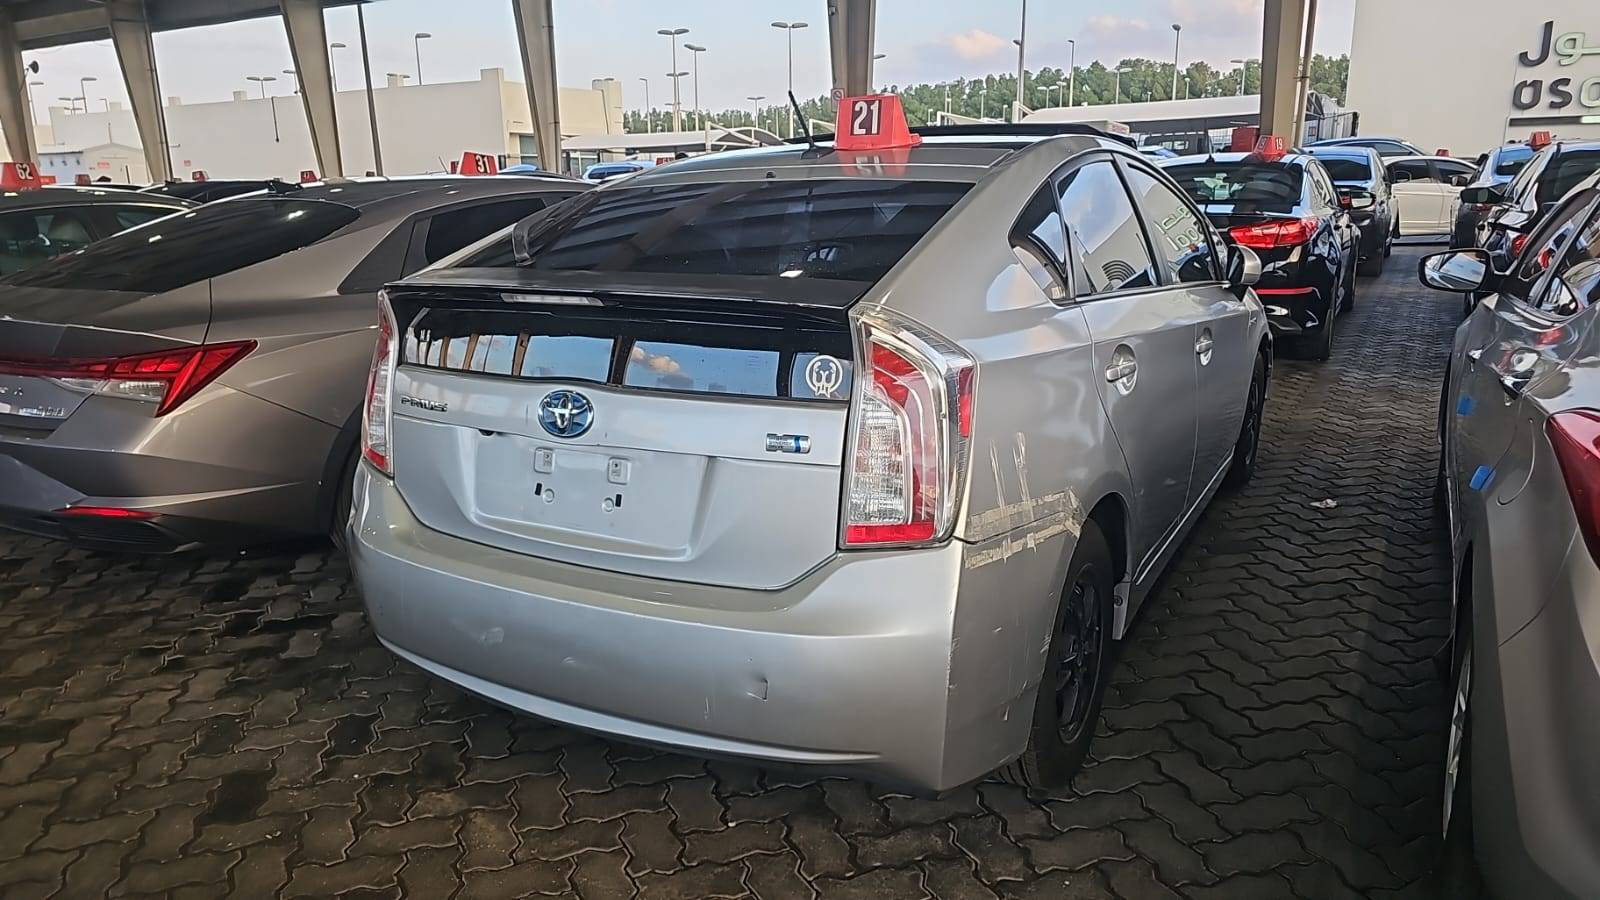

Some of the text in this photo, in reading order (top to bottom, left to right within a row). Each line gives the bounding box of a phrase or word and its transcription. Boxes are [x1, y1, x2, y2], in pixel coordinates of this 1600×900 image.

[853, 100, 880, 135] 21
[1275, 137, 1284, 151] 19
[16, 163, 34, 180] 62
[475, 154, 491, 174] 31
[400, 395, 448, 412] PRIUS
